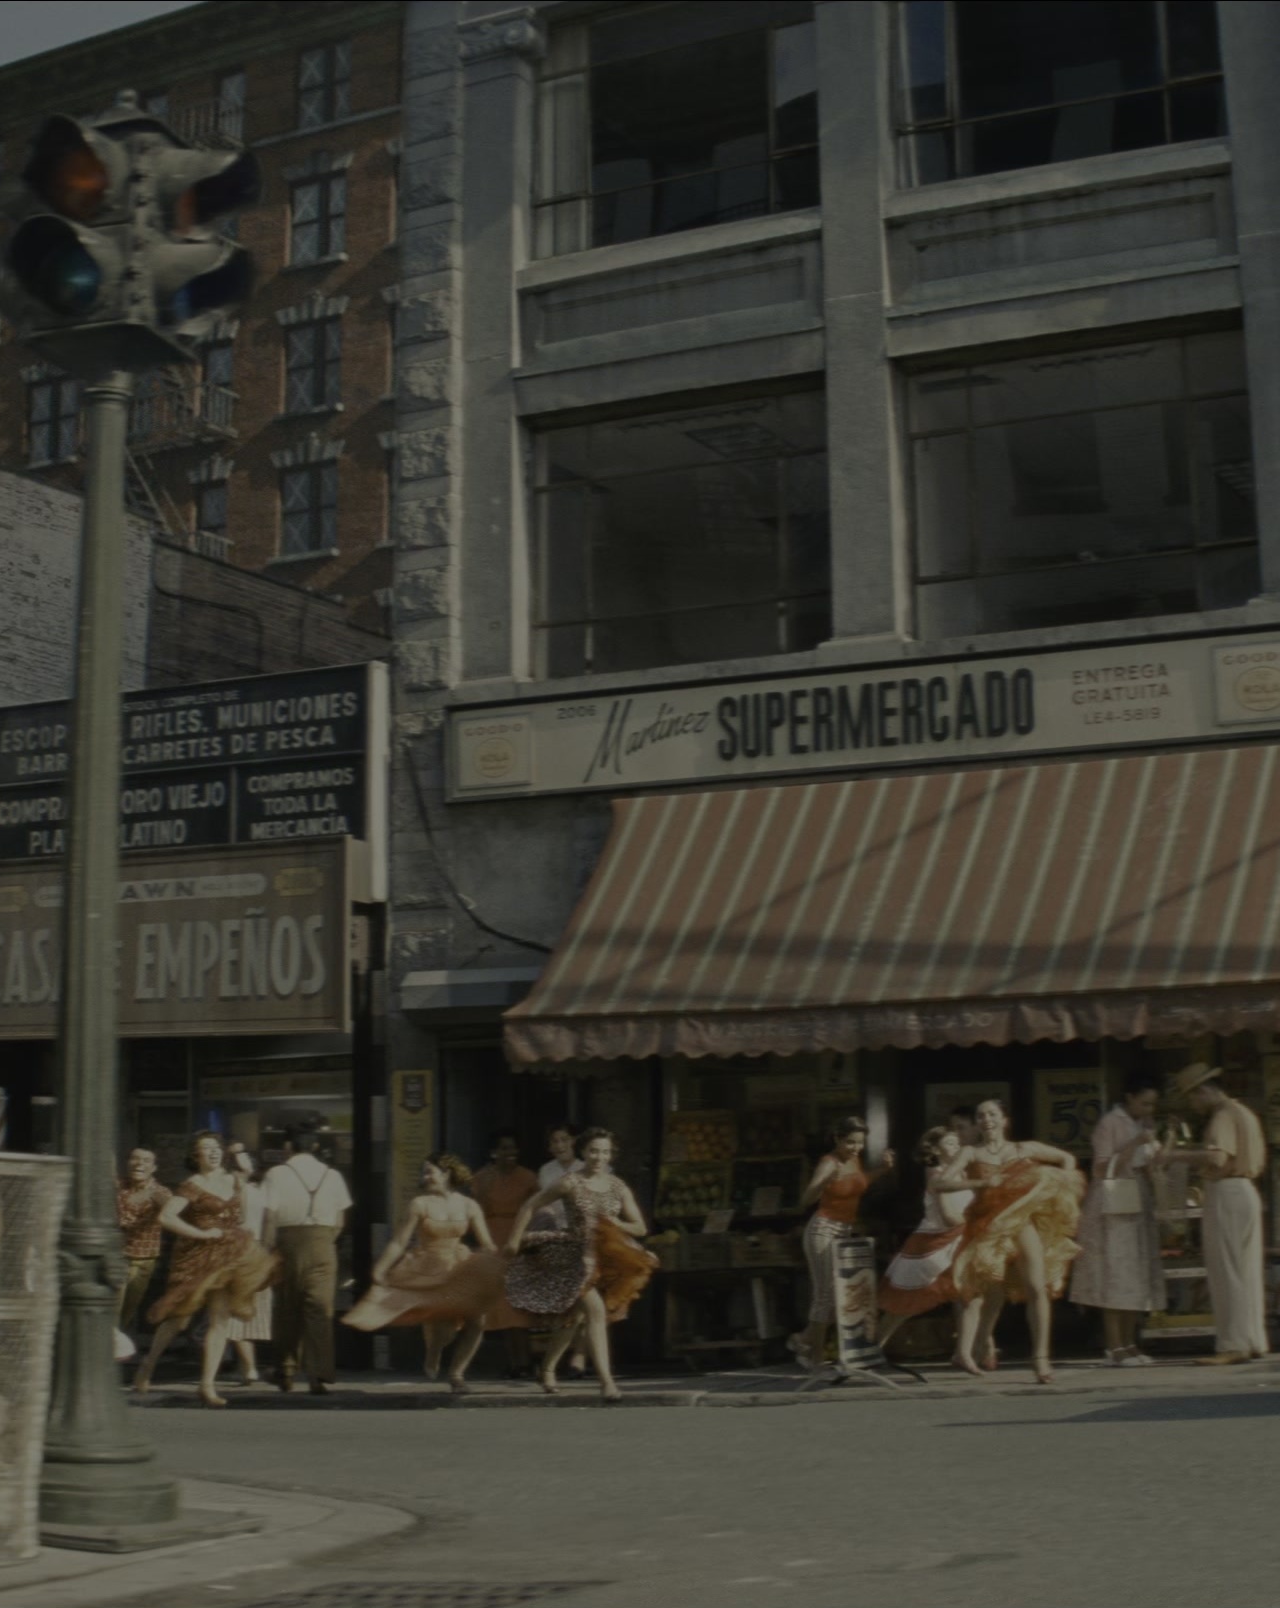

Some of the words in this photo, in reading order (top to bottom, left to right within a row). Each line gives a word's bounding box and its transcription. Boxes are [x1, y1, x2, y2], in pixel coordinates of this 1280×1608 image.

[1072, 662, 1169, 686] ENTREGA
[1072, 682, 1172, 705] GRATUITA
[0, 724, 68, 754] ESCOP
[217, 692, 357, 730] MUNICIONES
[716, 668, 1035, 762] SUPERMERCADO
[122, 736, 222, 766] CARRETES
[231, 731, 258, 754] DE
[265, 725, 336, 752] PESCA
[247, 767, 355, 794] COMPRAMOS
[122, 787, 162, 814] ORO
[168, 782, 225, 810] VIEJO
[263, 795, 310, 817] TODA
[313, 792, 337, 812] LA
[29, 828, 65, 855] PLA
[120, 819, 188, 849] LATINO
[122, 880, 197, 900] AWN
[135, 907, 326, 1000] EMPEÑOS
